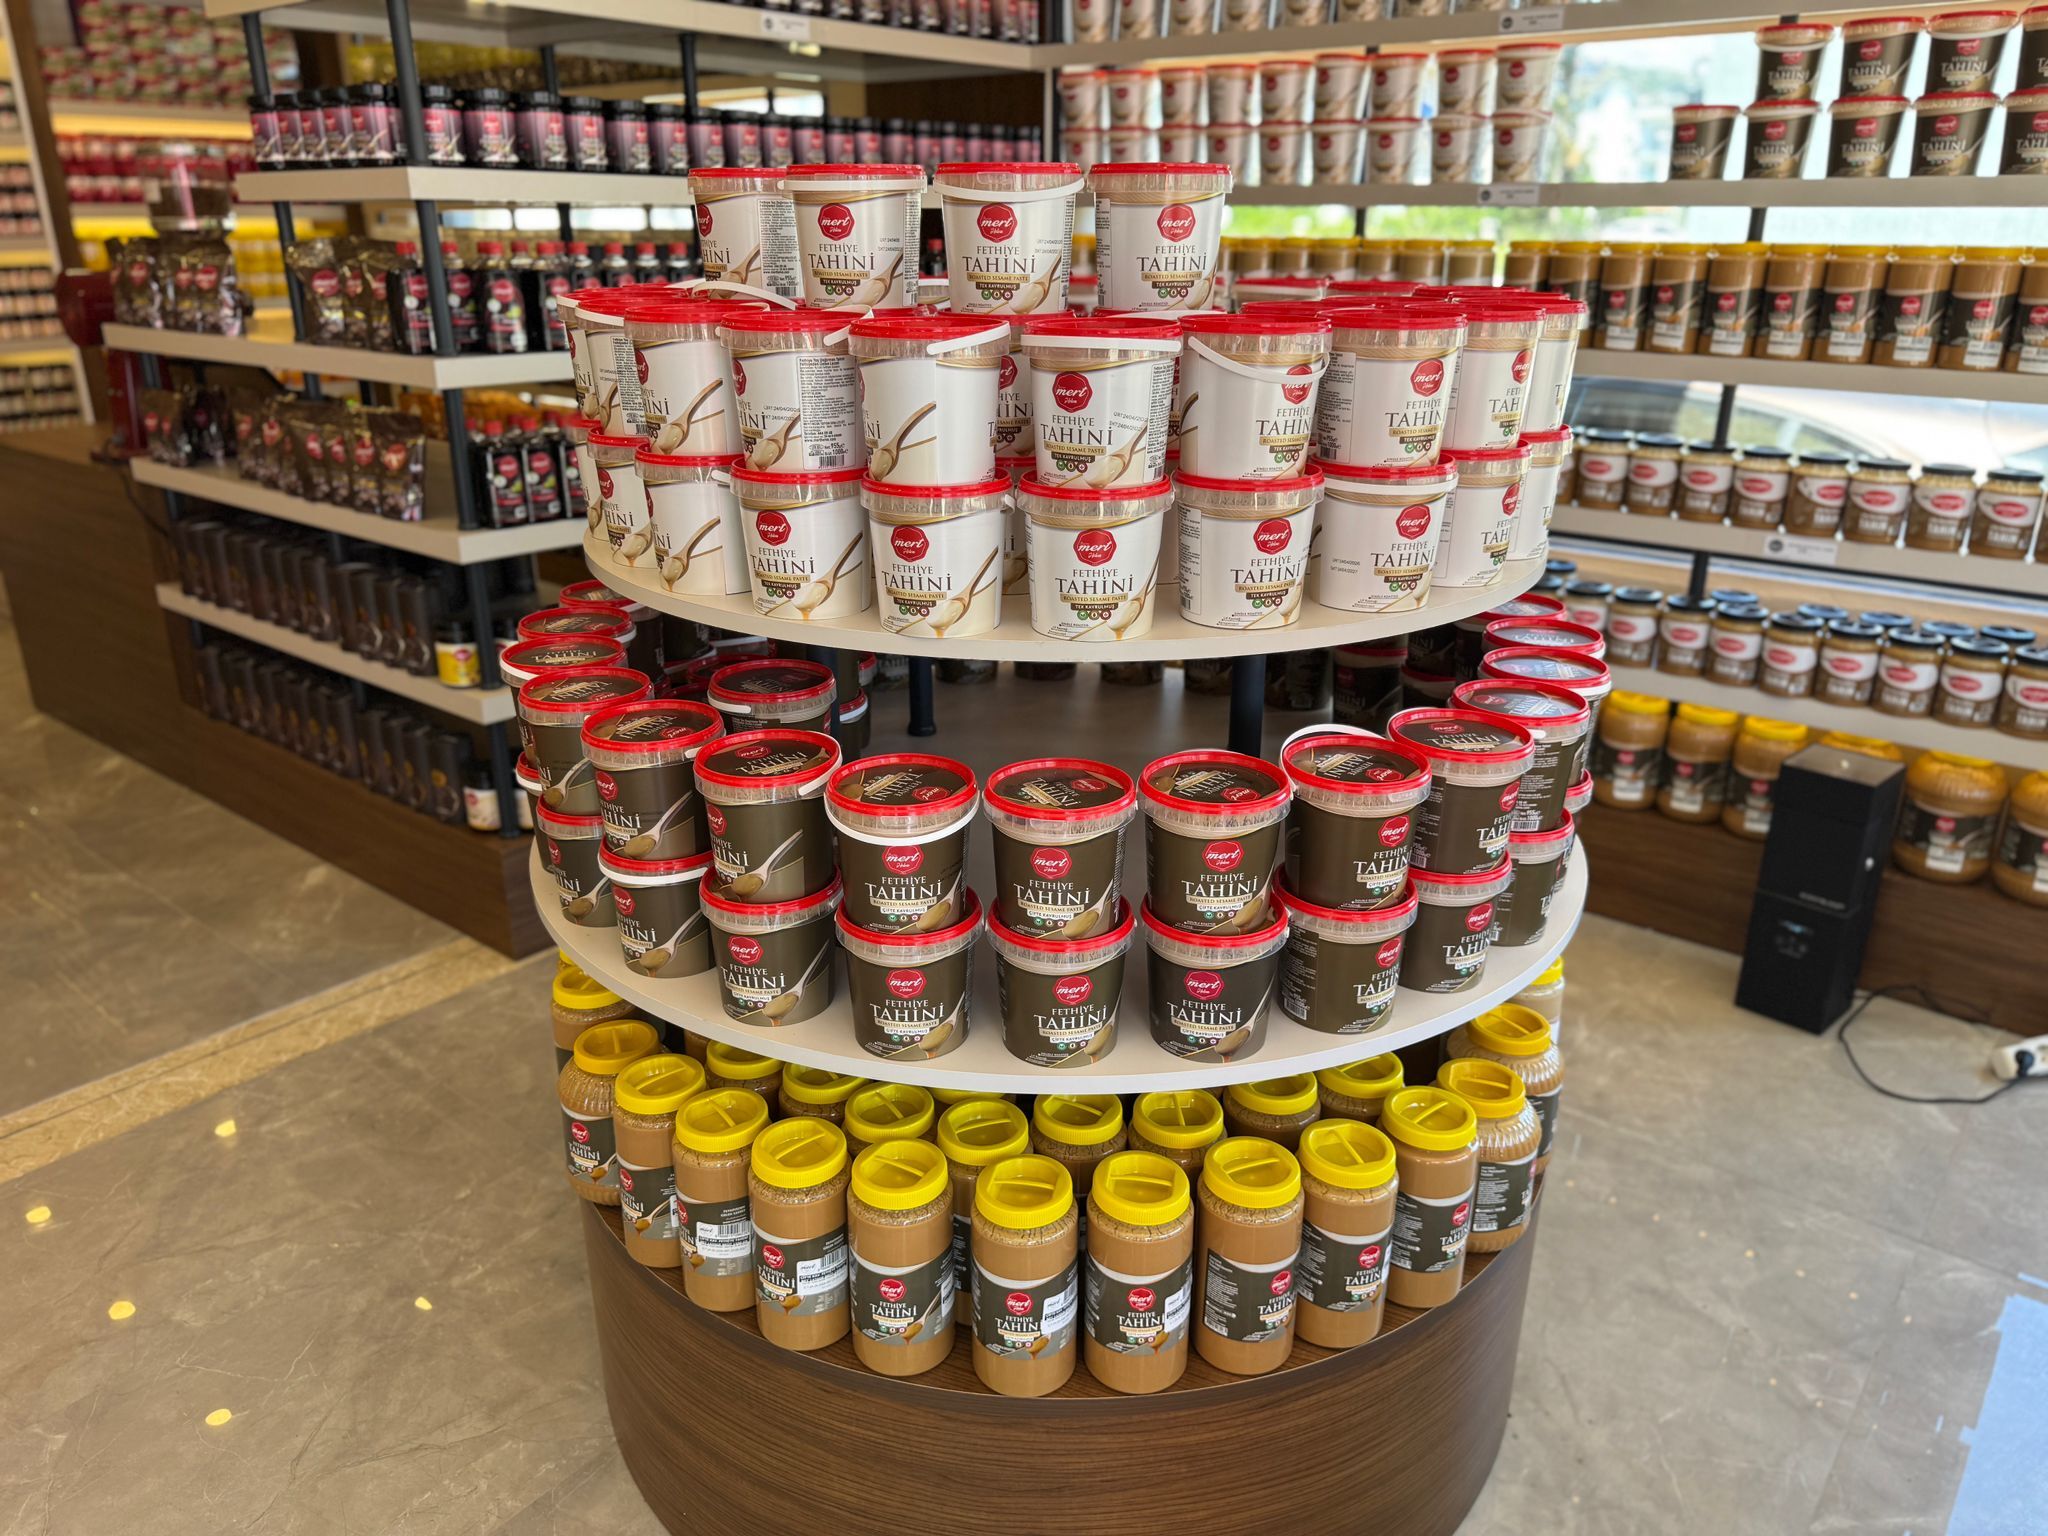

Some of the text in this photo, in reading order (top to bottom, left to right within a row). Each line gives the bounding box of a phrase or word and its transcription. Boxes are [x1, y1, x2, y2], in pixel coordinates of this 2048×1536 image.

[821, 216, 849, 229] mert
[981, 216, 1012, 228] mert
[1161, 217, 1192, 228] mert
[819, 244, 858, 253] FETHİYE
[977, 244, 1019, 255] FETHİYE
[1156, 244, 1195, 254] FETHİYE
[808, 252, 874, 272] TAHİNİ
[962, 254, 1036, 274] TAHİNİ
[1136, 252, 1207, 272] TAHİNİ
[1414, 371, 1442, 384] mert
[1056, 386, 1087, 398] mert
[1052, 414, 1094, 427] FETHİYE
[1041, 424, 1113, 446] TAHİNİ
[1400, 516, 1428, 528] mert
[759, 524, 786, 533] mert
[1258, 530, 1288, 542] mert
[894, 538, 924, 550] mert
[1078, 541, 1111, 554] mert
[1391, 540, 1428, 552] FETHİYE
[758, 547, 796, 558] FETHİYE
[750, 556, 815, 574] TAHİNİ
[1251, 555, 1292, 566] FETHİYE
[892, 564, 934, 574] FETHİYE
[1073, 568, 1118, 578] FETHİYE
[1230, 562, 1301, 584] TAHİNİ
[882, 570, 952, 591] TAHİNİ
[1055, 574, 1133, 594] TAHİNİ
[1426, 734, 1502, 746] TAHİNİ
[736, 752, 808, 774] TAHİNİ
[1324, 753, 1374, 778] TAHİNİ
[868, 773, 924, 802] TAHİNİ
[1178, 771, 1238, 798] TAHİNİ
[1031, 778, 1082, 807] TAHİNİ
[1231, 789, 1250, 800] mert
[1382, 822, 1409, 837] mert
[886, 852, 920, 864] mert
[1206, 849, 1240, 860] mert
[1035, 857, 1068, 867] mert
[882, 875, 926, 885] FETHİYE
[1200, 872, 1244, 882] FETHİYE
[864, 880, 942, 900] TAHİNİ
[1030, 880, 1074, 890] FETHİYE
[1182, 876, 1258, 898] TAHİNİ
[1014, 883, 1090, 906] TAHİNİ
[731, 944, 759, 954] mert
[730, 964, 768, 976] FETHİYE
[721, 966, 786, 988] TAHİNİ
[890, 978, 922, 987] mert
[1057, 983, 1090, 995] mert
[1188, 980, 1220, 990] mert
[886, 999, 928, 1008] FETHİYE
[1052, 1003, 1094, 1016] FETHİYE
[1182, 999, 1226, 1012] FETHİYE
[870, 1002, 944, 1022] TAHİNİ
[1034, 1004, 1108, 1030] TAHİNİ
[1167, 1002, 1242, 1024] TAHİNİ
[757, 1265, 796, 1289] TAHİNİ
[870, 1303, 917, 1318] TAHİNİ
